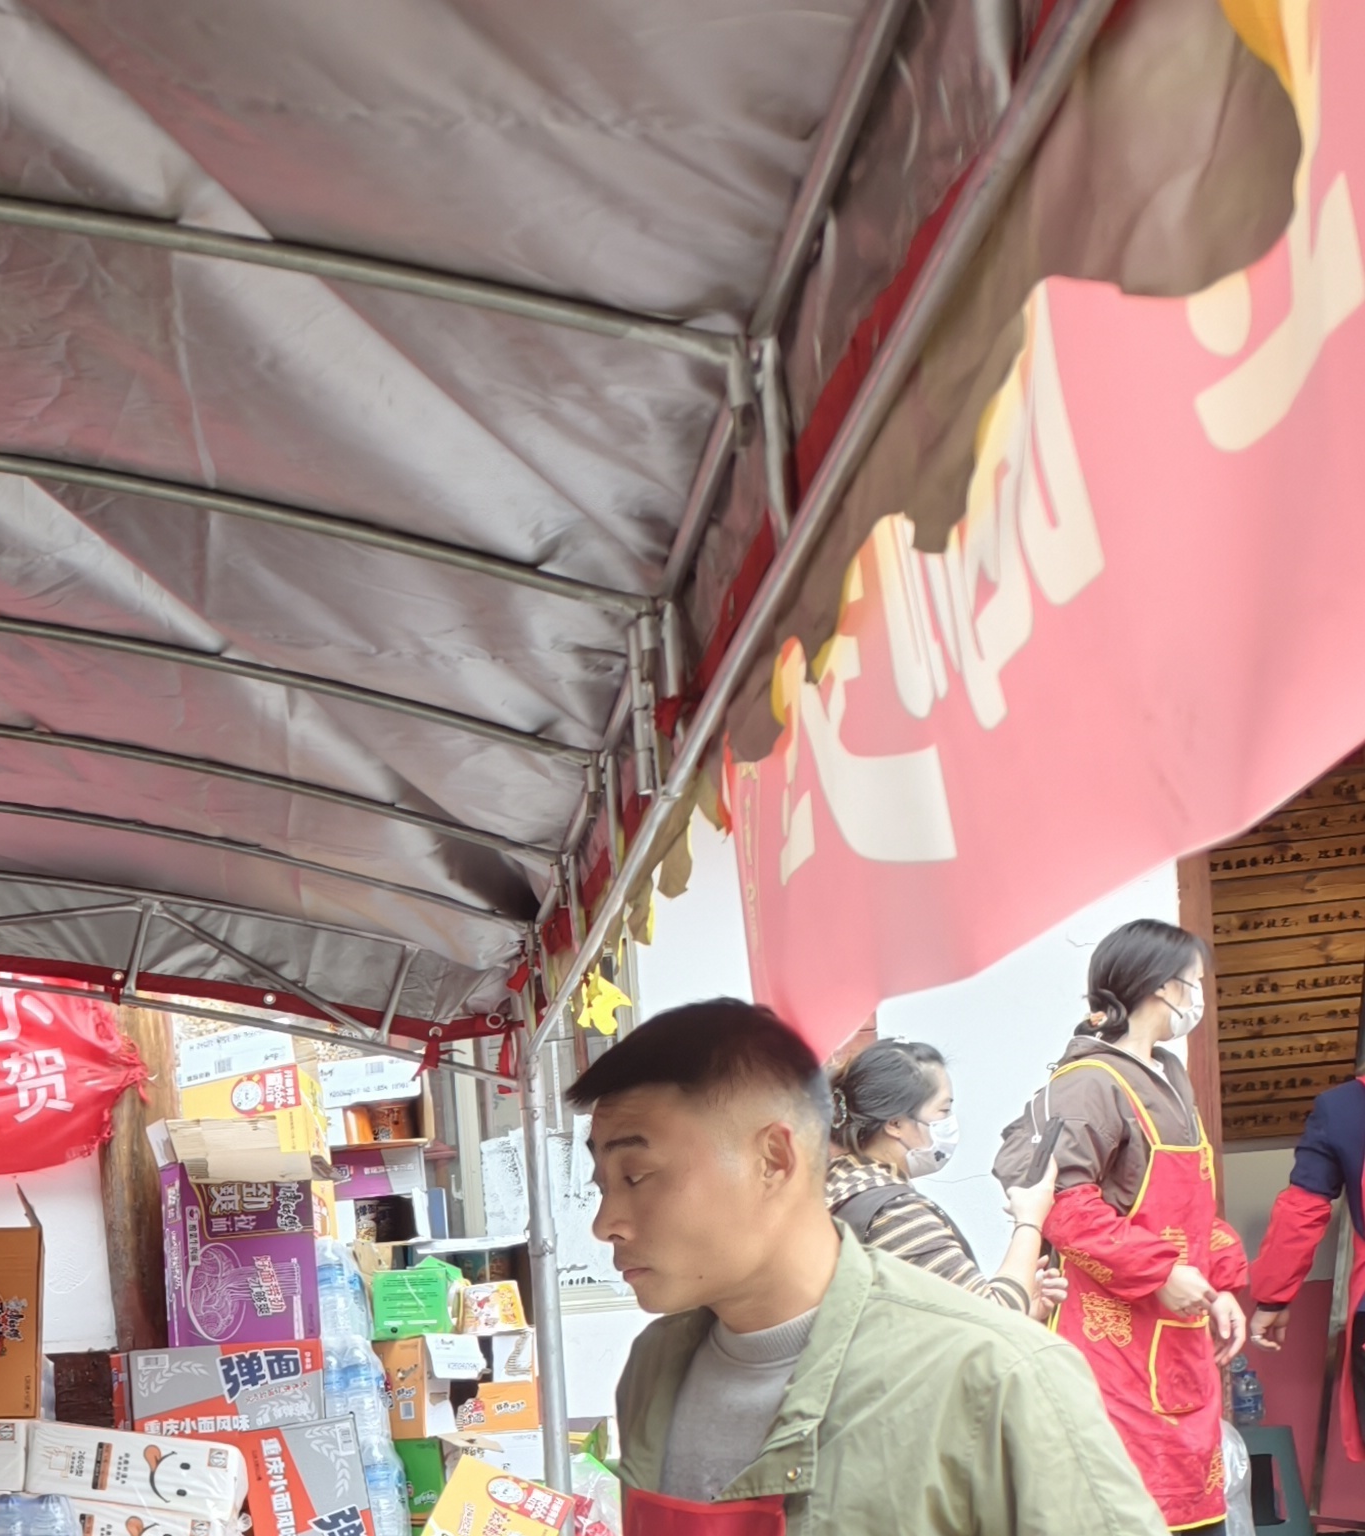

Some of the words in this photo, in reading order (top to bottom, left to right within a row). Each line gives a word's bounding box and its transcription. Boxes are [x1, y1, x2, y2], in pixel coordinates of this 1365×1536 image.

[211, 1214, 257, 1233] 拉面
[219, 1348, 302, 1402] 弹面
[144, 1414, 251, 1436] 重庆小面风味
